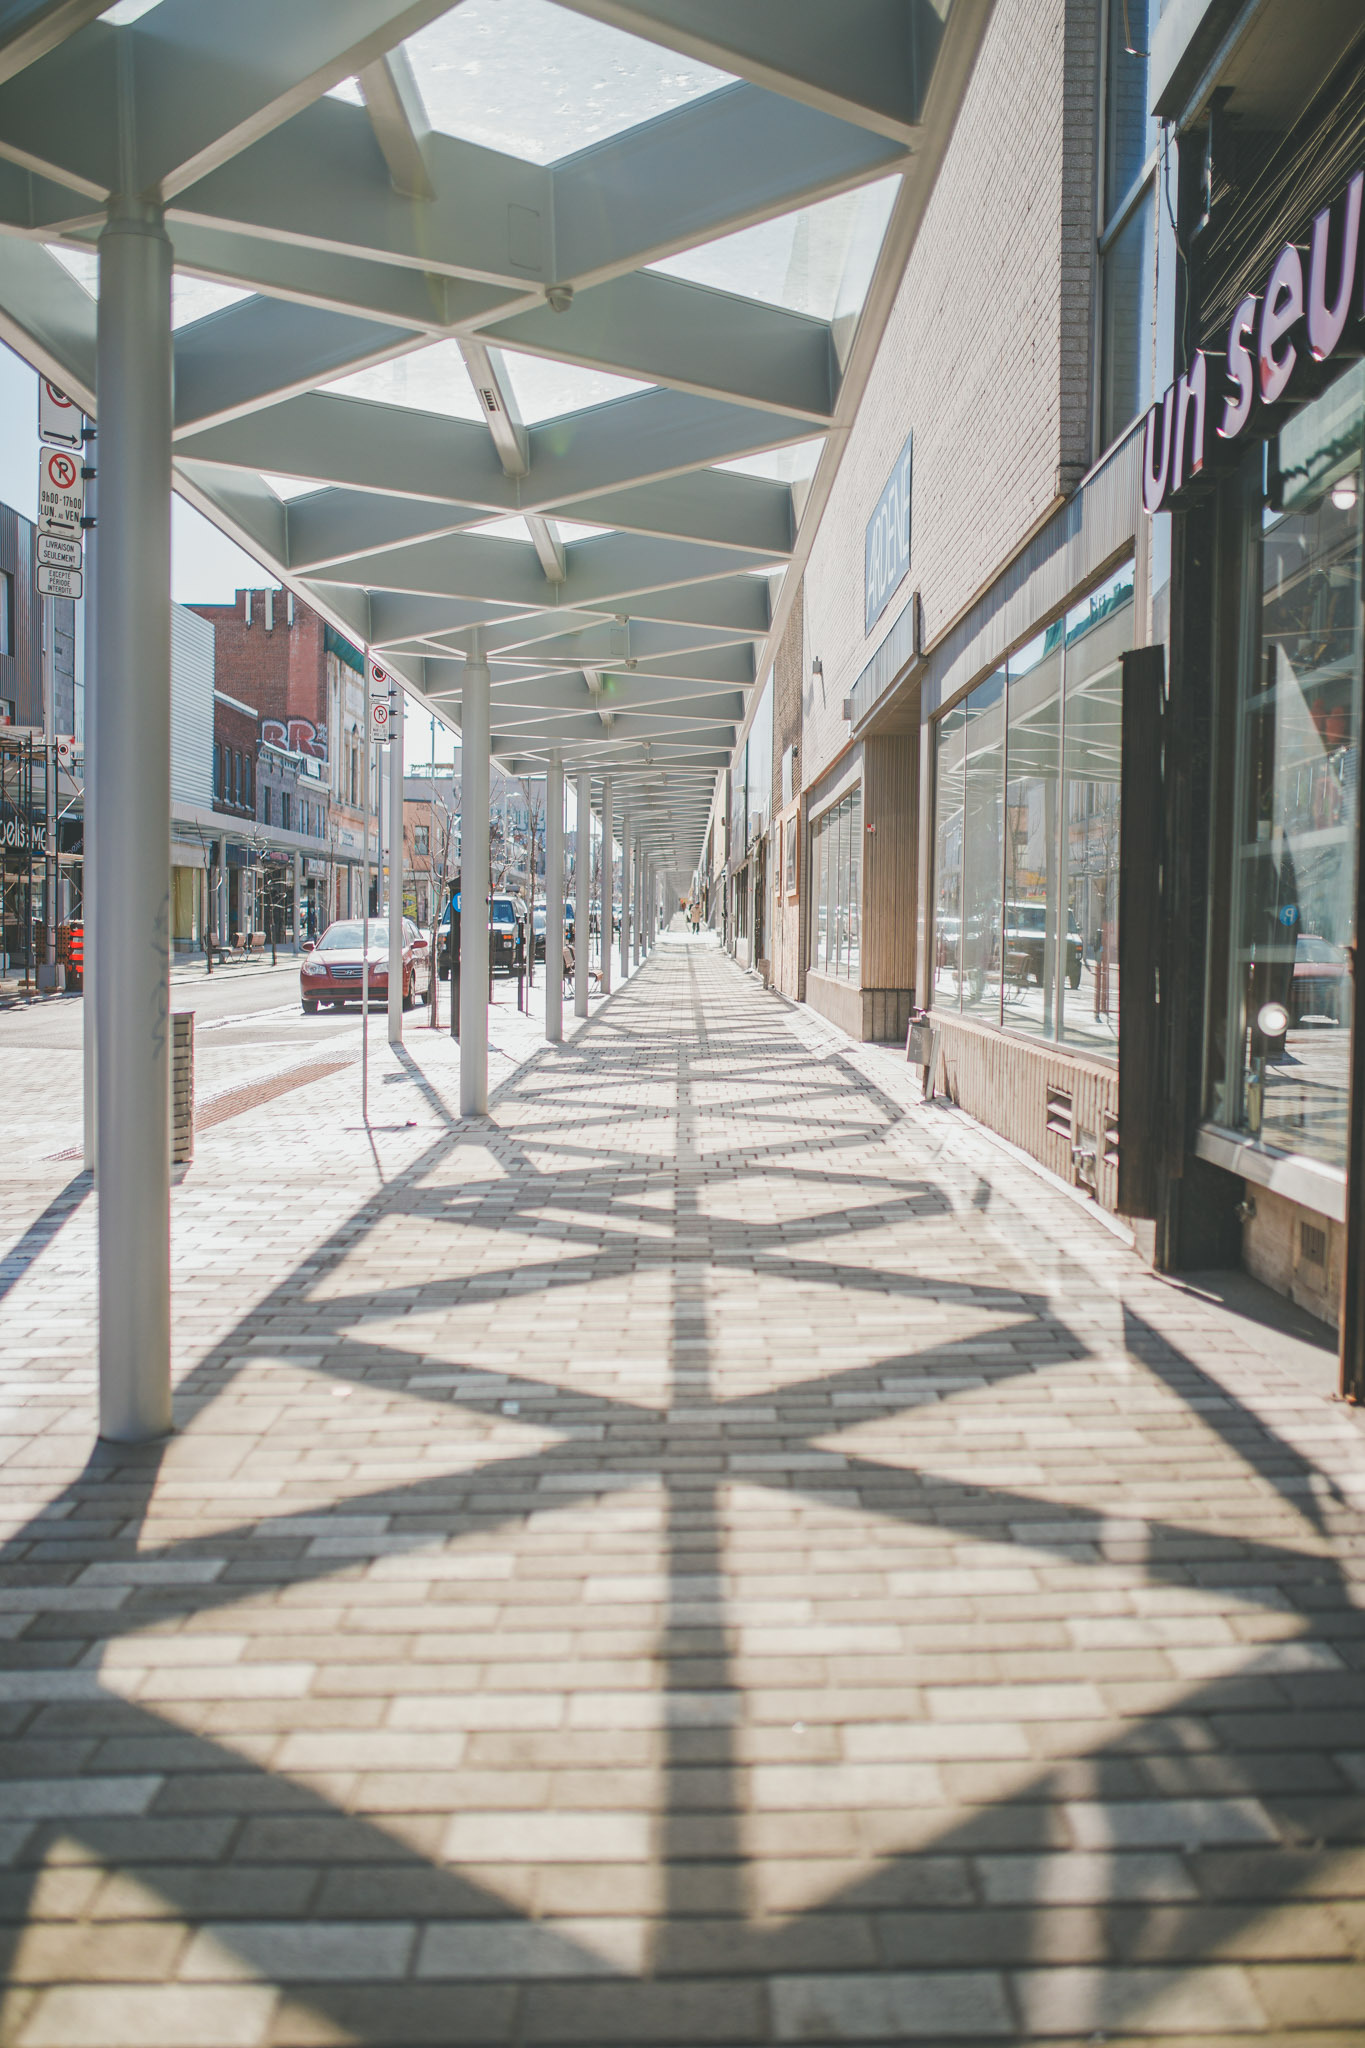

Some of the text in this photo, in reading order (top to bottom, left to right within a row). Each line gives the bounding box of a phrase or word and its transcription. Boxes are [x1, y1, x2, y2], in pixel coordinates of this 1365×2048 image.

[1216, 169, 1365, 440] seu
[40, 505, 57, 517] LUN.
[865, 450, 911, 625] ARDENE
[45, 540, 75, 552] LIVRAISON
[43, 550, 76, 563] SEULEMENT
[49, 569, 71, 579] EXCEPTÉ
[49, 577, 71, 587] PÉRIODE
[47, 584, 73, 595] INTERDITE
